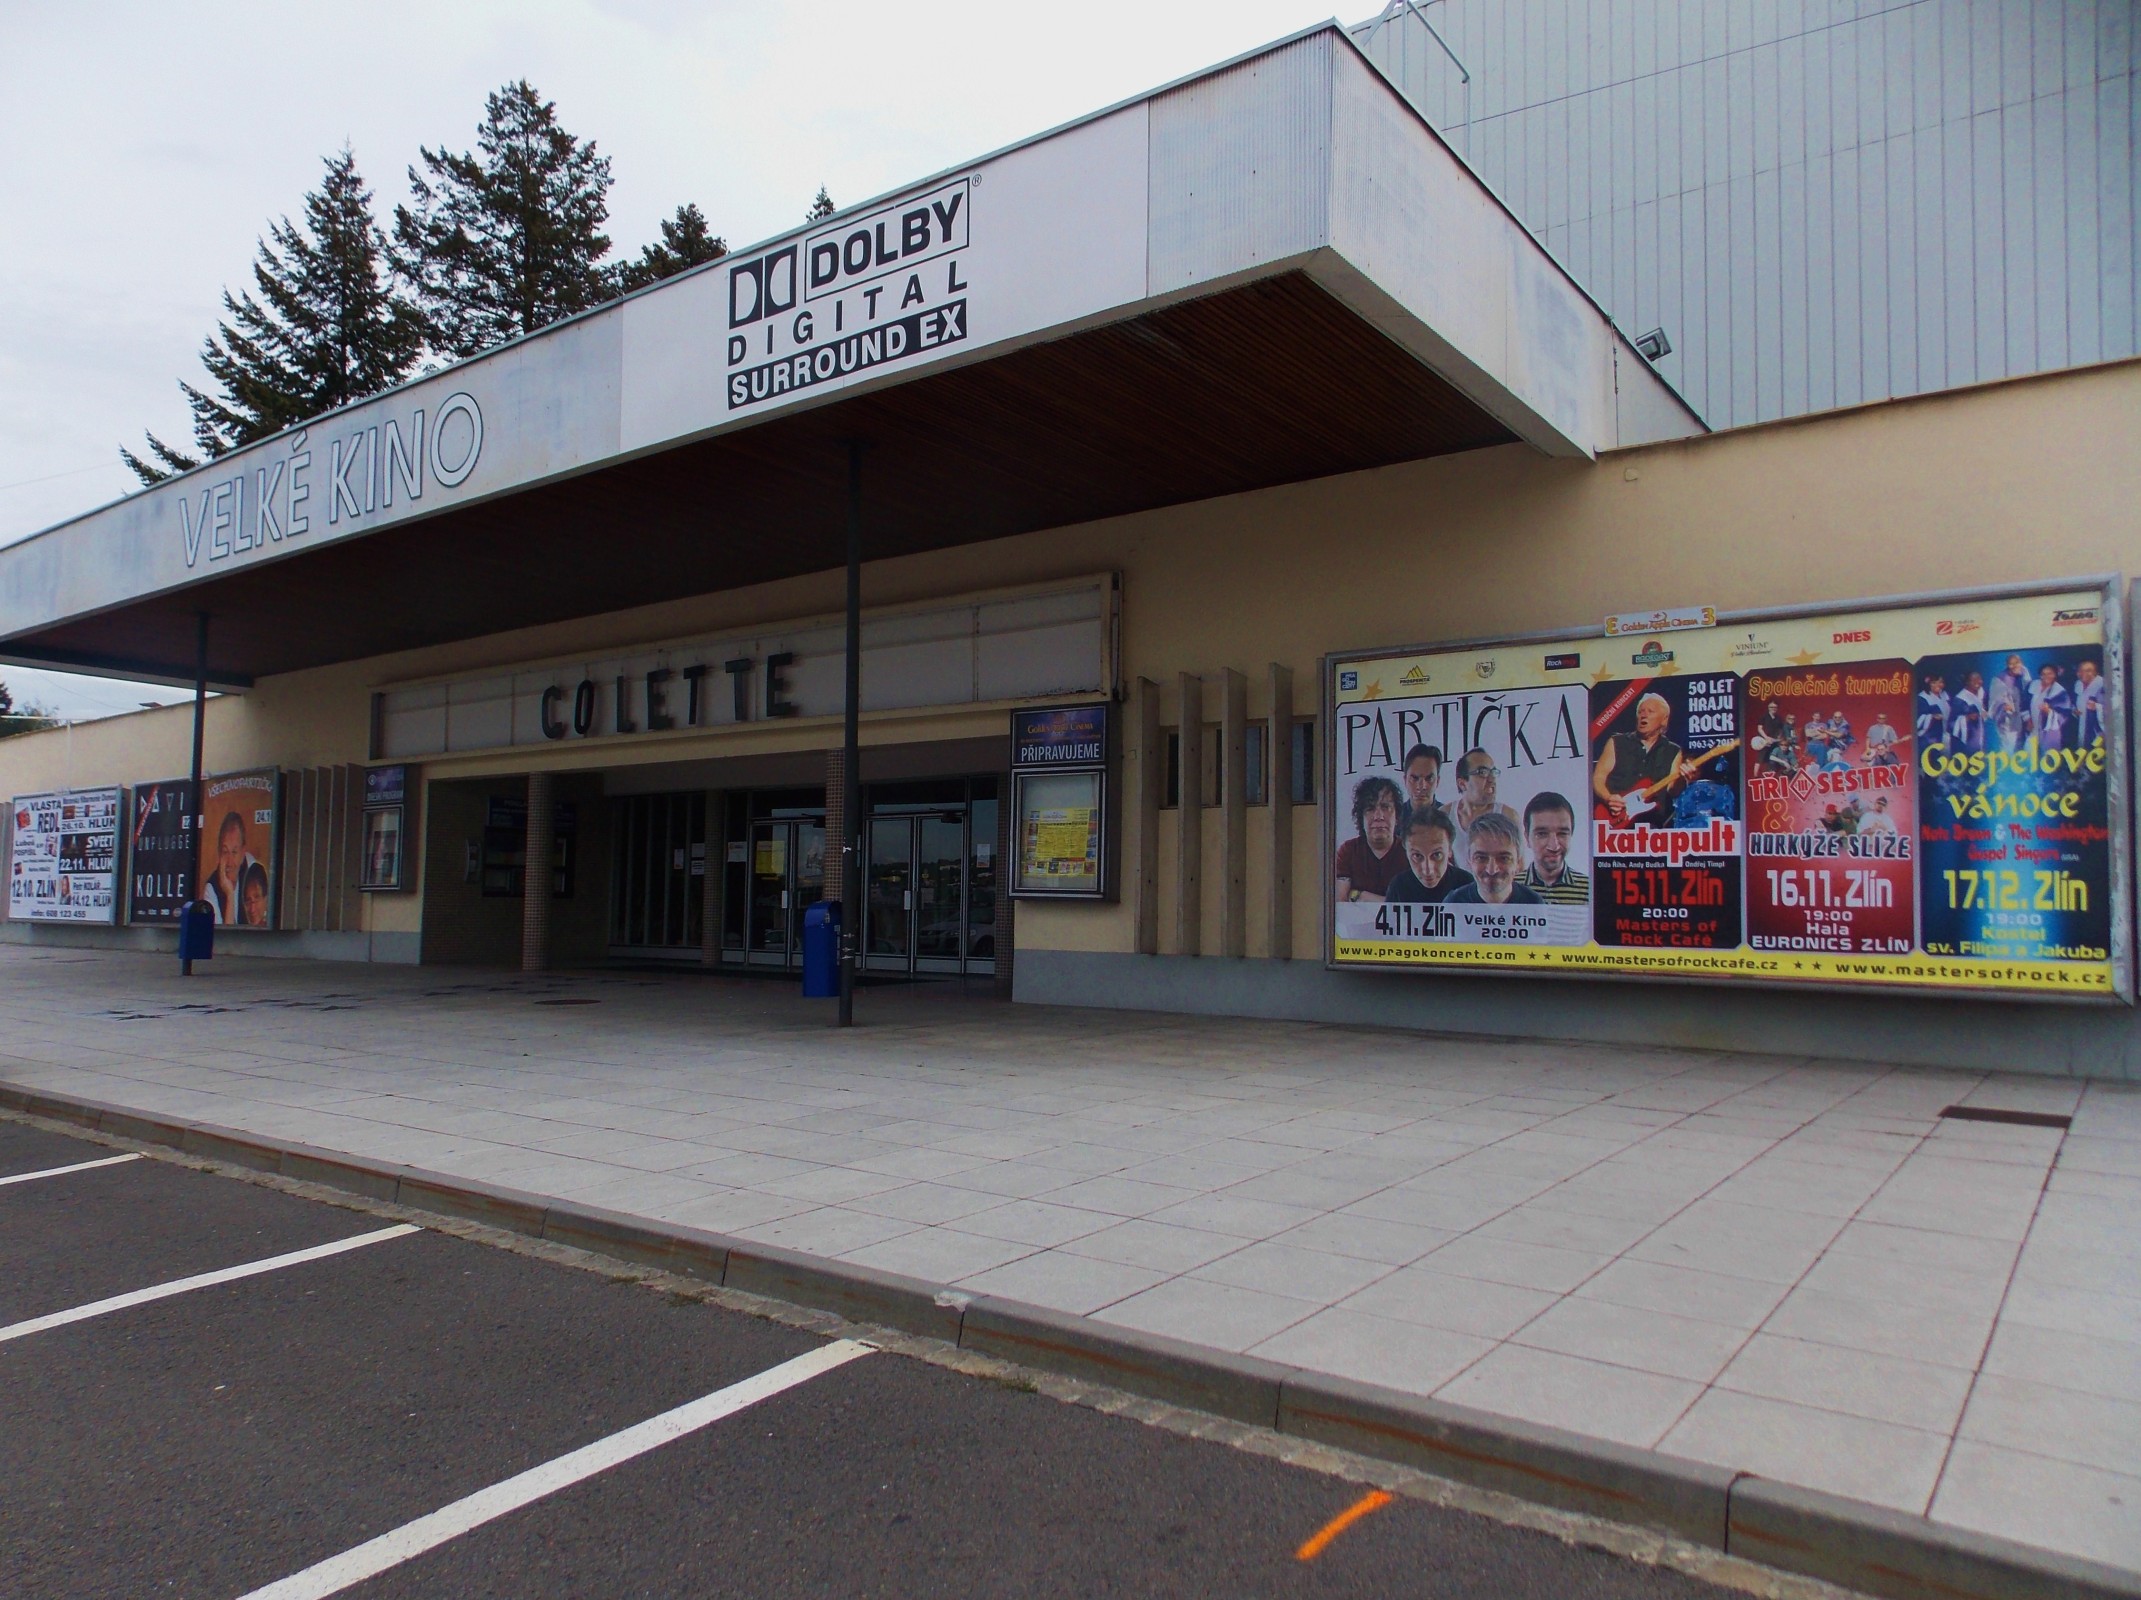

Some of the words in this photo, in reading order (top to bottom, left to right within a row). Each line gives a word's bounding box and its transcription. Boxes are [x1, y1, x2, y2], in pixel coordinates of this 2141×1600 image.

[811, 192, 964, 289] DOLBY
[728, 261, 967, 366] DIGITAL
[731, 324, 907, 405] SURROUND
[920, 305, 962, 348] EX
[179, 431, 311, 567] VELKÉ
[329, 392, 484, 525] KINO
[1833, 631, 1871, 644] DNES
[541, 652, 794, 739] COLETTE
[1688, 681, 1706, 696] 50
[1709, 679, 1735, 694] LET
[1749, 674, 1839, 701] Společné
[1845, 672, 1909, 695] turné!
[1688, 695, 1733, 712] HRAJU
[1688, 713, 1734, 733] ROCK
[1340, 694, 1584, 775] PARTIČKA
[1021, 743, 1100, 762] PŘIPRAVUJEME
[1688, 739, 1706, 749] 1963
[1921, 736, 2106, 786] Gospelové
[1749, 772, 1789, 801] TŘI
[1817, 764, 1907, 795] SESTRY
[30, 800, 62, 811] VLASTA
[1947, 783, 2080, 819] vánoce
[38, 812, 60, 834] REDL
[1762, 798, 1794, 834] &
[2008, 823, 2032, 840] The
[138, 834, 190, 850] UNPLUGGE
[1597, 820, 1735, 864] katapult
[1750, 829, 1839, 859] HORKÝŽE
[1849, 829, 1911, 859] SLÍŽE
[61, 858, 86, 870] 22.11.
[1629, 861, 1644, 869] Andy
[1685, 860, 1706, 868] Ondřej
[1708, 860, 1725, 868] Timpl
[13, 880, 34, 898] 12.10.
[136, 873, 185, 898] KOLLE
[1943, 870, 2029, 910] 17.12.
[2034, 870, 2088, 911] Zlín
[71, 894, 91, 907] 14.12.
[1464, 914, 1506, 926] Velké
[1512, 914, 1547, 927] Kino
[1642, 908, 1688, 918] 20:00
[1804, 910, 1853, 922] 19:00
[1987, 913, 2043, 926] 19:00
[1481, 928, 1529, 939] 20:00
[1616, 919, 1690, 932] Masters
[1698, 919, 1718, 932] of
[1806, 923, 1850, 935] Hala
[1982, 926, 2047, 941] Kostel
[1621, 933, 1663, 946] Rock
[1752, 935, 1852, 950] EURONICS
[1861, 936, 1909, 952] ZLÍN
[1926, 942, 1954, 954] sv.
[2034, 944, 2107, 960] Jakuba
[1340, 946, 1516, 961] www.pragokoncert.com
[1561, 953, 1778, 970] www.mastersofrockcafe.cz
[1836, 963, 2106, 984] www.mastersofrock.cz
